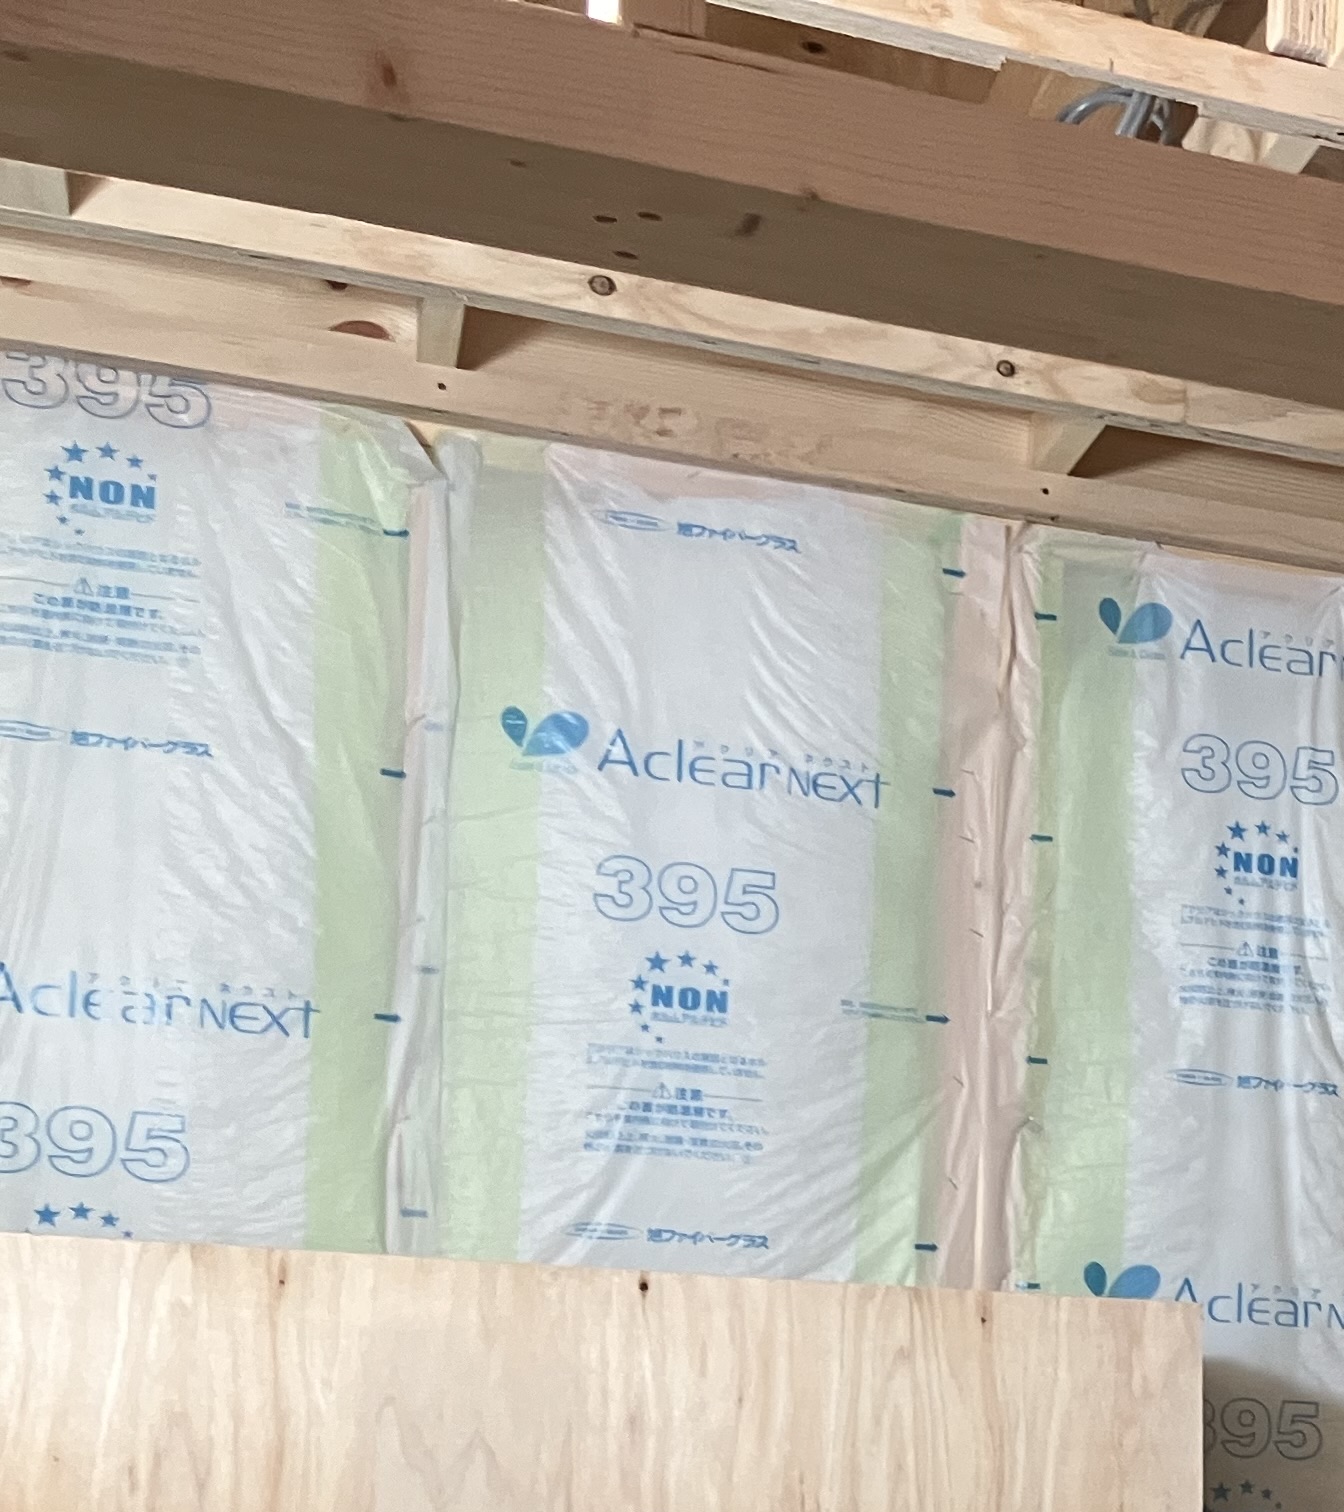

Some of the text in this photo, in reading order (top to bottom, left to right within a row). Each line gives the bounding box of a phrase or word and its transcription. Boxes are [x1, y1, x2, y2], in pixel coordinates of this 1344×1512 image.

[1, 353, 212, 429] 395
[69, 475, 157, 509] NON
[1181, 734, 1339, 805] 395
[594, 855, 780, 934] 395
[1233, 851, 1299, 878] NON
[652, 983, 729, 1014] NON
[0, 1101, 190, 1182] 395
[1204, 1398, 1323, 1460] 95
